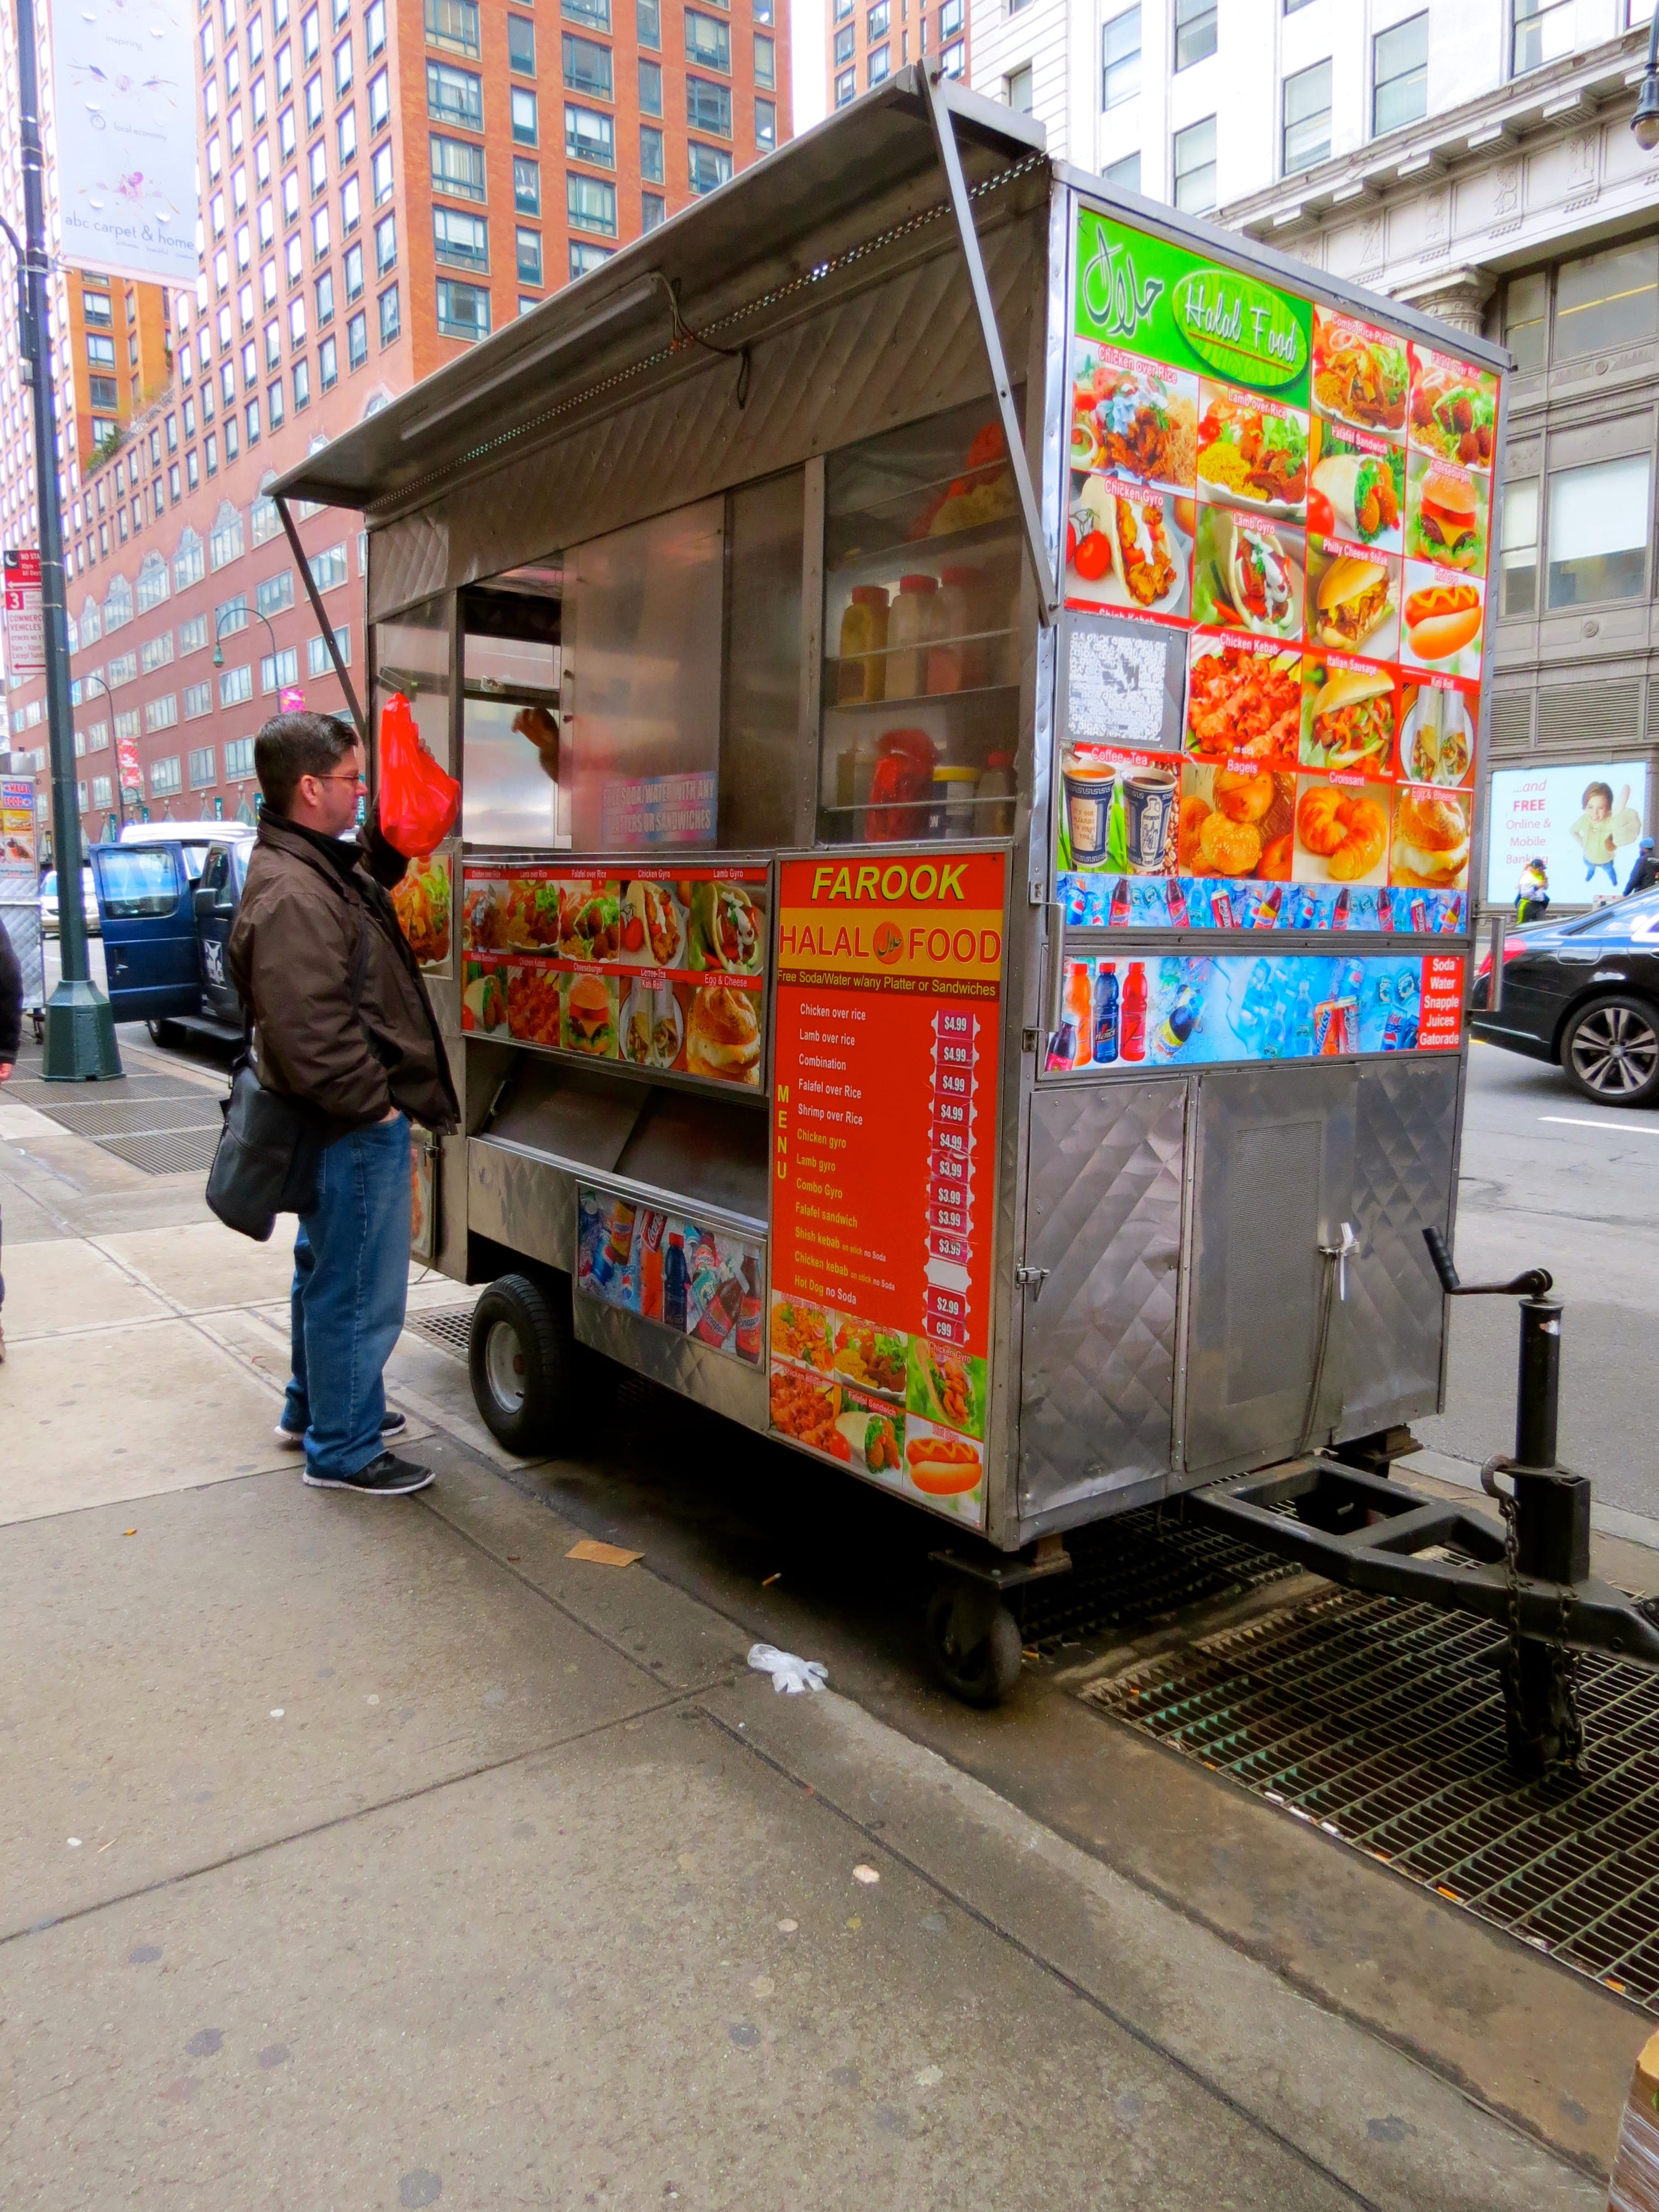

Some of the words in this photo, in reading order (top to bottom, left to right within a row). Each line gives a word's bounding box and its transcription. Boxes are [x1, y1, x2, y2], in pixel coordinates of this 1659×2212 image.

[106, 34, 143, 52] inspiring
[114, 121, 131, 134] local
[133, 127, 168, 142] economy
[65, 211, 89, 229] abc
[94, 221, 136, 240] carpet
[142, 225, 154, 242] &
[159, 227, 194, 250] home
[1185, 284, 1241, 342] Halal
[1250, 306, 1297, 363] Food
[1332, 313, 1357, 332] Combo
[1358, 323, 1373, 337] Rice
[1374, 328, 1397, 349] Platter
[1098, 345, 1135, 372] Chicken
[1136, 361, 1156, 377] over
[1157, 366, 1177, 384] Rice
[1431, 352, 1452, 372] Falafel
[1453, 361, 1464, 375] over
[1465, 365, 1481, 382] Rice
[1228, 388, 1250, 407] Lamb
[1251, 397, 1270, 413] over
[1271, 402, 1287, 419] Rice
[1332, 424, 1355, 442] Falafel
[1356, 432, 1387, 455] Sandwich
[1430, 459, 1470, 483] Cheeseburger
[1104, 478, 1140, 499] Chicken
[1142, 489, 1164, 508] Gyro
[1233, 511, 1254, 529] Lamb
[1255, 518, 1275, 536] Gyro
[1323, 538, 1343, 555] Philly
[1344, 544, 1368, 562] Cheese
[1370, 553, 1389, 567] Steak
[1447, 572, 1459, 588] Dog
[10, 592, 20, 609] 3
[9, 614, 42, 622] COMMERC
[10, 623, 41, 632] VEHICLES
[1219, 633, 1252, 650] Chicken
[1254, 638, 1279, 655] Kebab
[1328, 654, 1348, 671] Italian
[1349, 660, 1377, 677] Sausage
[1442, 677, 1454, 691] Roll
[1241, 746, 1254, 756] stick
[1227, 759, 1258, 774] Bagels
[1329, 772, 1365, 787] Croissant
[9, 784, 30, 794] HALAL
[698, 779, 714, 800] ANY
[1411, 787, 1426, 802] Egg
[1426, 790, 1432, 800] &
[1433, 791, 1457, 802] Cheese
[5, 796, 23, 806] FOOD
[1513, 799, 1545, 812] FREE
[644, 812, 654, 832] OR
[656, 809, 711, 831] SANDWICHES
[1506, 820, 1541, 830] Online
[1543, 818, 1551, 828] &
[1510, 836, 1546, 847] Mobile
[1506, 854, 1548, 865] Banking
[571, 870, 586, 879] Falafel
[597, 870, 607, 879] Rice
[638, 869, 658, 879] Chicken
[658, 870, 671, 880] Gyro
[713, 869, 727, 878] Lamb
[729, 869, 743, 880] Gyro
[811, 864, 969, 901] FAROOK
[778, 925, 870, 959] HALAL
[907, 927, 1001, 964] FOOD
[573, 963, 603, 975] Cheeseburger
[1432, 958, 1455, 972] Soda
[641, 979, 651, 989] Kati
[705, 974, 717, 985] Egg
[718, 975, 723, 984] &
[724, 975, 748, 988] Cheese
[778, 969, 796, 983] Free
[799, 972, 851, 986] Soda/Water
[853, 975, 881, 991] w/any
[884, 977, 915, 991] Platter
[919, 982, 929, 991] or
[932, 980, 995, 997] Sandwiches
[1430, 977, 1455, 990] Water
[1424, 994, 1459, 1011] Snapple
[800, 1003, 830, 1017] Chicken
[832, 1009, 849, 1020] over
[852, 1009, 866, 1021] rice
[1427, 1014, 1454, 1027] Juices
[944, 1016, 967, 1032] $4.99
[799, 1029, 820, 1042] Lamb
[822, 1034, 839, 1045] over
[841, 1035, 855, 1046] rice
[1420, 1032, 1459, 1045] Gatorade
[799, 1053, 846, 1071] Combination
[943, 1046, 966, 1062] $4.99
[799, 1078, 823, 1093] Falafel
[826, 1084, 842, 1097] over
[844, 1086, 862, 1099] Rice
[942, 1076, 965, 1093] $4.99
[798, 1103, 825, 1120] Shrimp
[826, 1109, 843, 1122] over
[846, 1112, 863, 1126] Rice
[941, 1104, 963, 1121] $4.99
[797, 1128, 827, 1145] Chicken
[829, 1135, 847, 1150] gyro
[940, 1132, 962, 1150] $4.99
[797, 1154, 817, 1168] Lamb
[818, 1159, 836, 1172] gyro
[940, 1160, 962, 1178] $3.99
[796, 1177, 823, 1194] Combo
[825, 1185, 843, 1199] Gyro
[938, 1187, 961, 1206] $3.99
[796, 1201, 820, 1219] Falafel
[822, 1208, 858, 1228] sandwich
[938, 1210, 961, 1227] $3.99
[795, 1226, 816, 1243] Shish
[818, 1232, 840, 1249] kebab
[850, 1244, 863, 1256] stick
[864, 1249, 872, 1258] no
[872, 1250, 886, 1262] Soda
[939, 1239, 961, 1256] $3.99
[795, 1250, 824, 1270] Chicken
[826, 1259, 848, 1277] kebab
[858, 1272, 872, 1284] stick
[873, 1278, 880, 1286] no
[881, 1279, 895, 1291] Soda
[794, 1275, 807, 1290] Hot
[809, 1280, 824, 1296] Dog
[826, 1286, 836, 1297] no
[837, 1288, 857, 1305] Soda
[937, 1296, 959, 1316] $2.99
[851, 1316, 868, 1328] Lamb
[883, 1324, 896, 1339] Rice
[929, 1341, 954, 1357] Chicken
[956, 1350, 972, 1364] Gyro
[848, 1391, 868, 1406] Falafel
[869, 1399, 896, 1417] Sandwich
[945, 1429, 959, 1444] Dog
